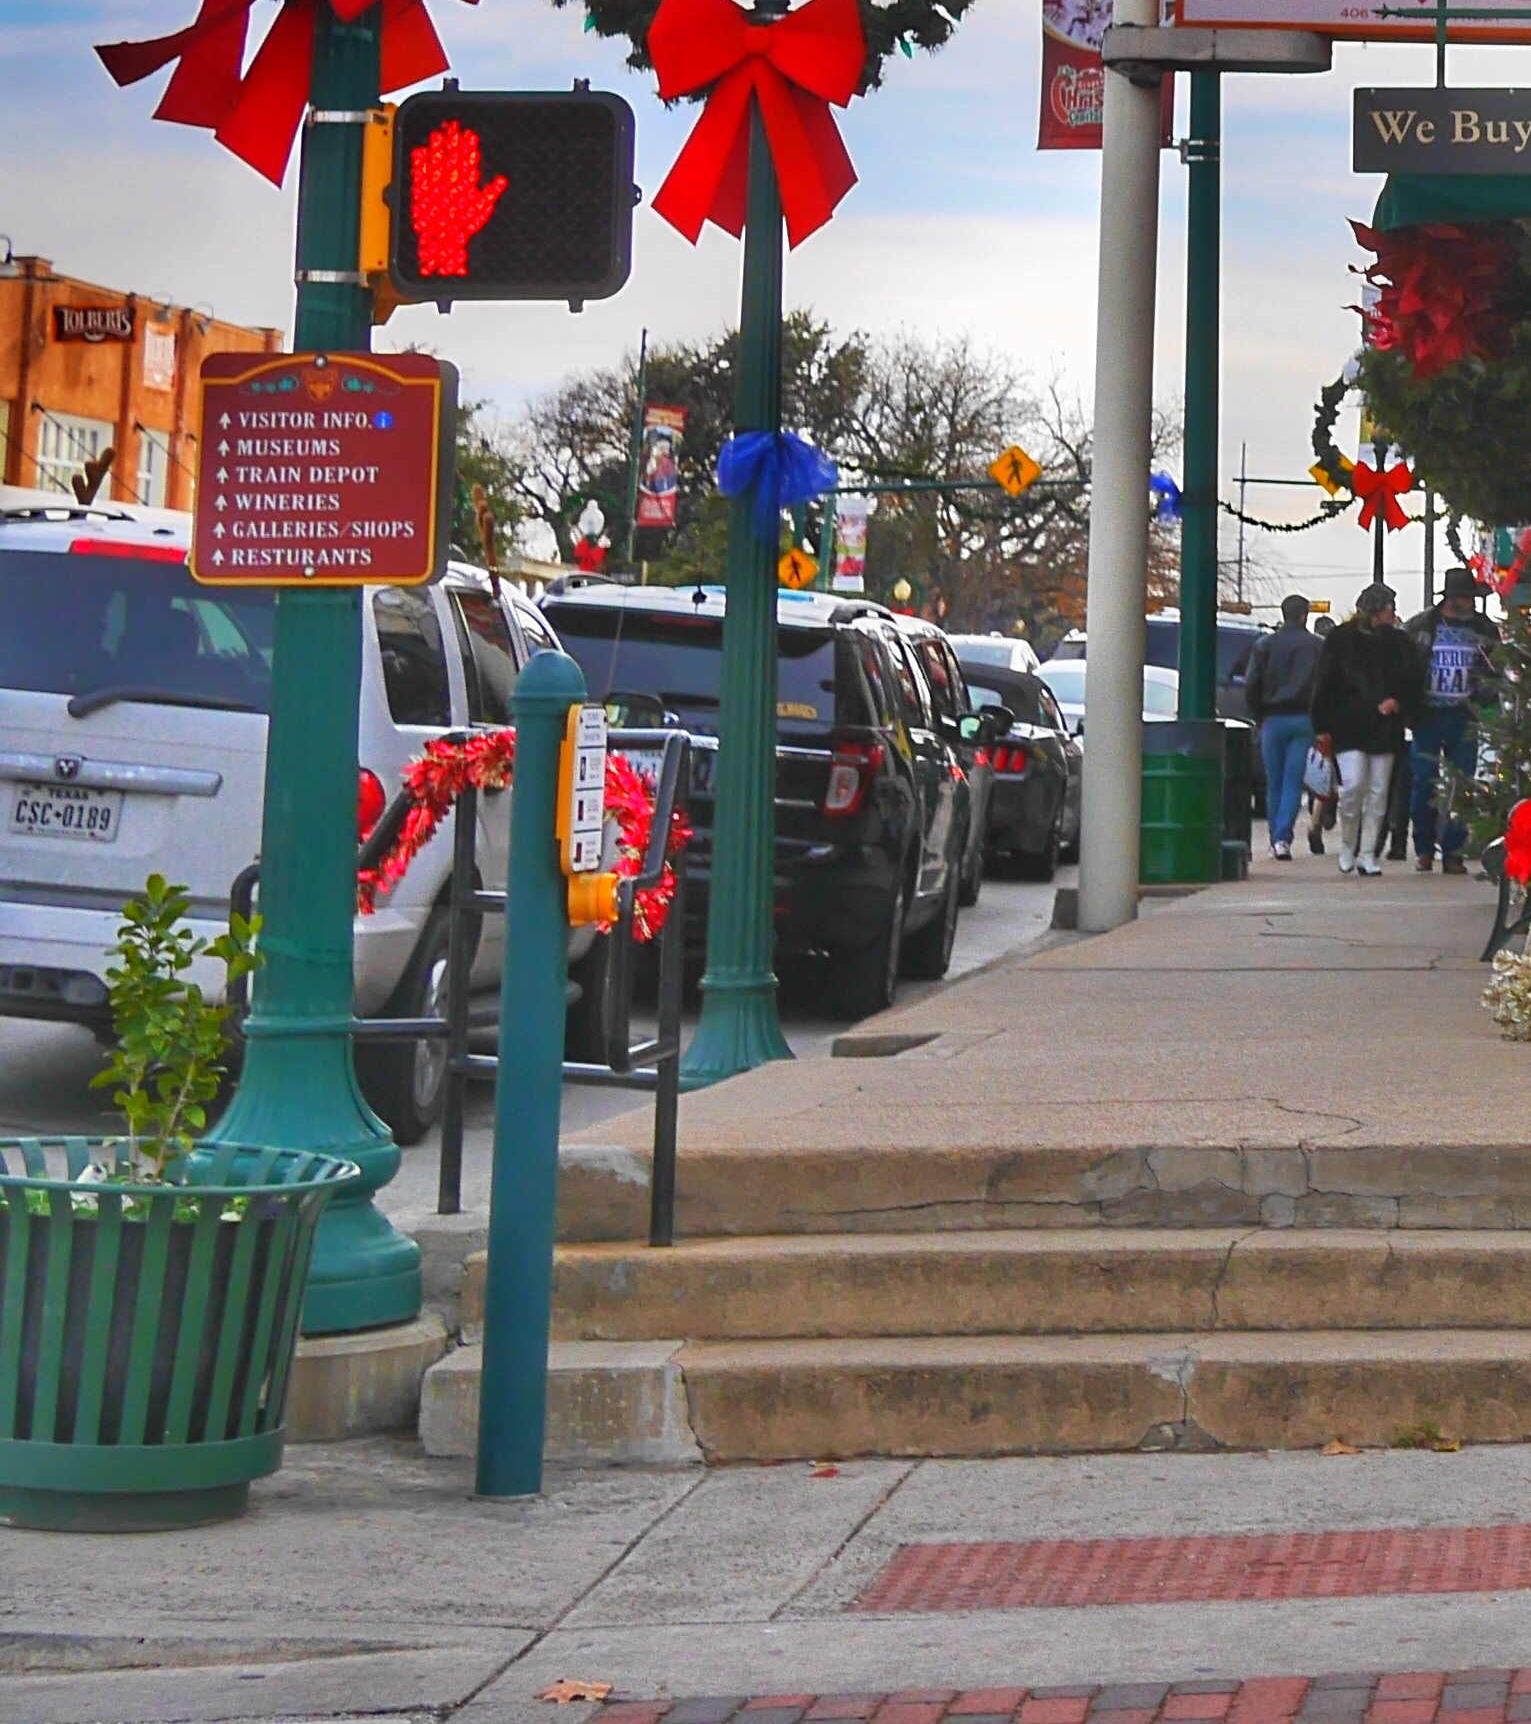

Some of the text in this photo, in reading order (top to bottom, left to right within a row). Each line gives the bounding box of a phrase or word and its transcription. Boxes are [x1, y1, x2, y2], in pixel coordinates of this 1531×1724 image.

[1340, 7, 1369, 18] 406
[1370, 109, 1436, 144] We
[238, 412, 372, 429] VISITOR INFO.
[237, 439, 341, 456] MUSEUMS
[236, 466, 379, 484] TRAIN DEPOT
[235, 494, 340, 511] WINERIES
[231, 548, 372, 566] RESTURANTS
